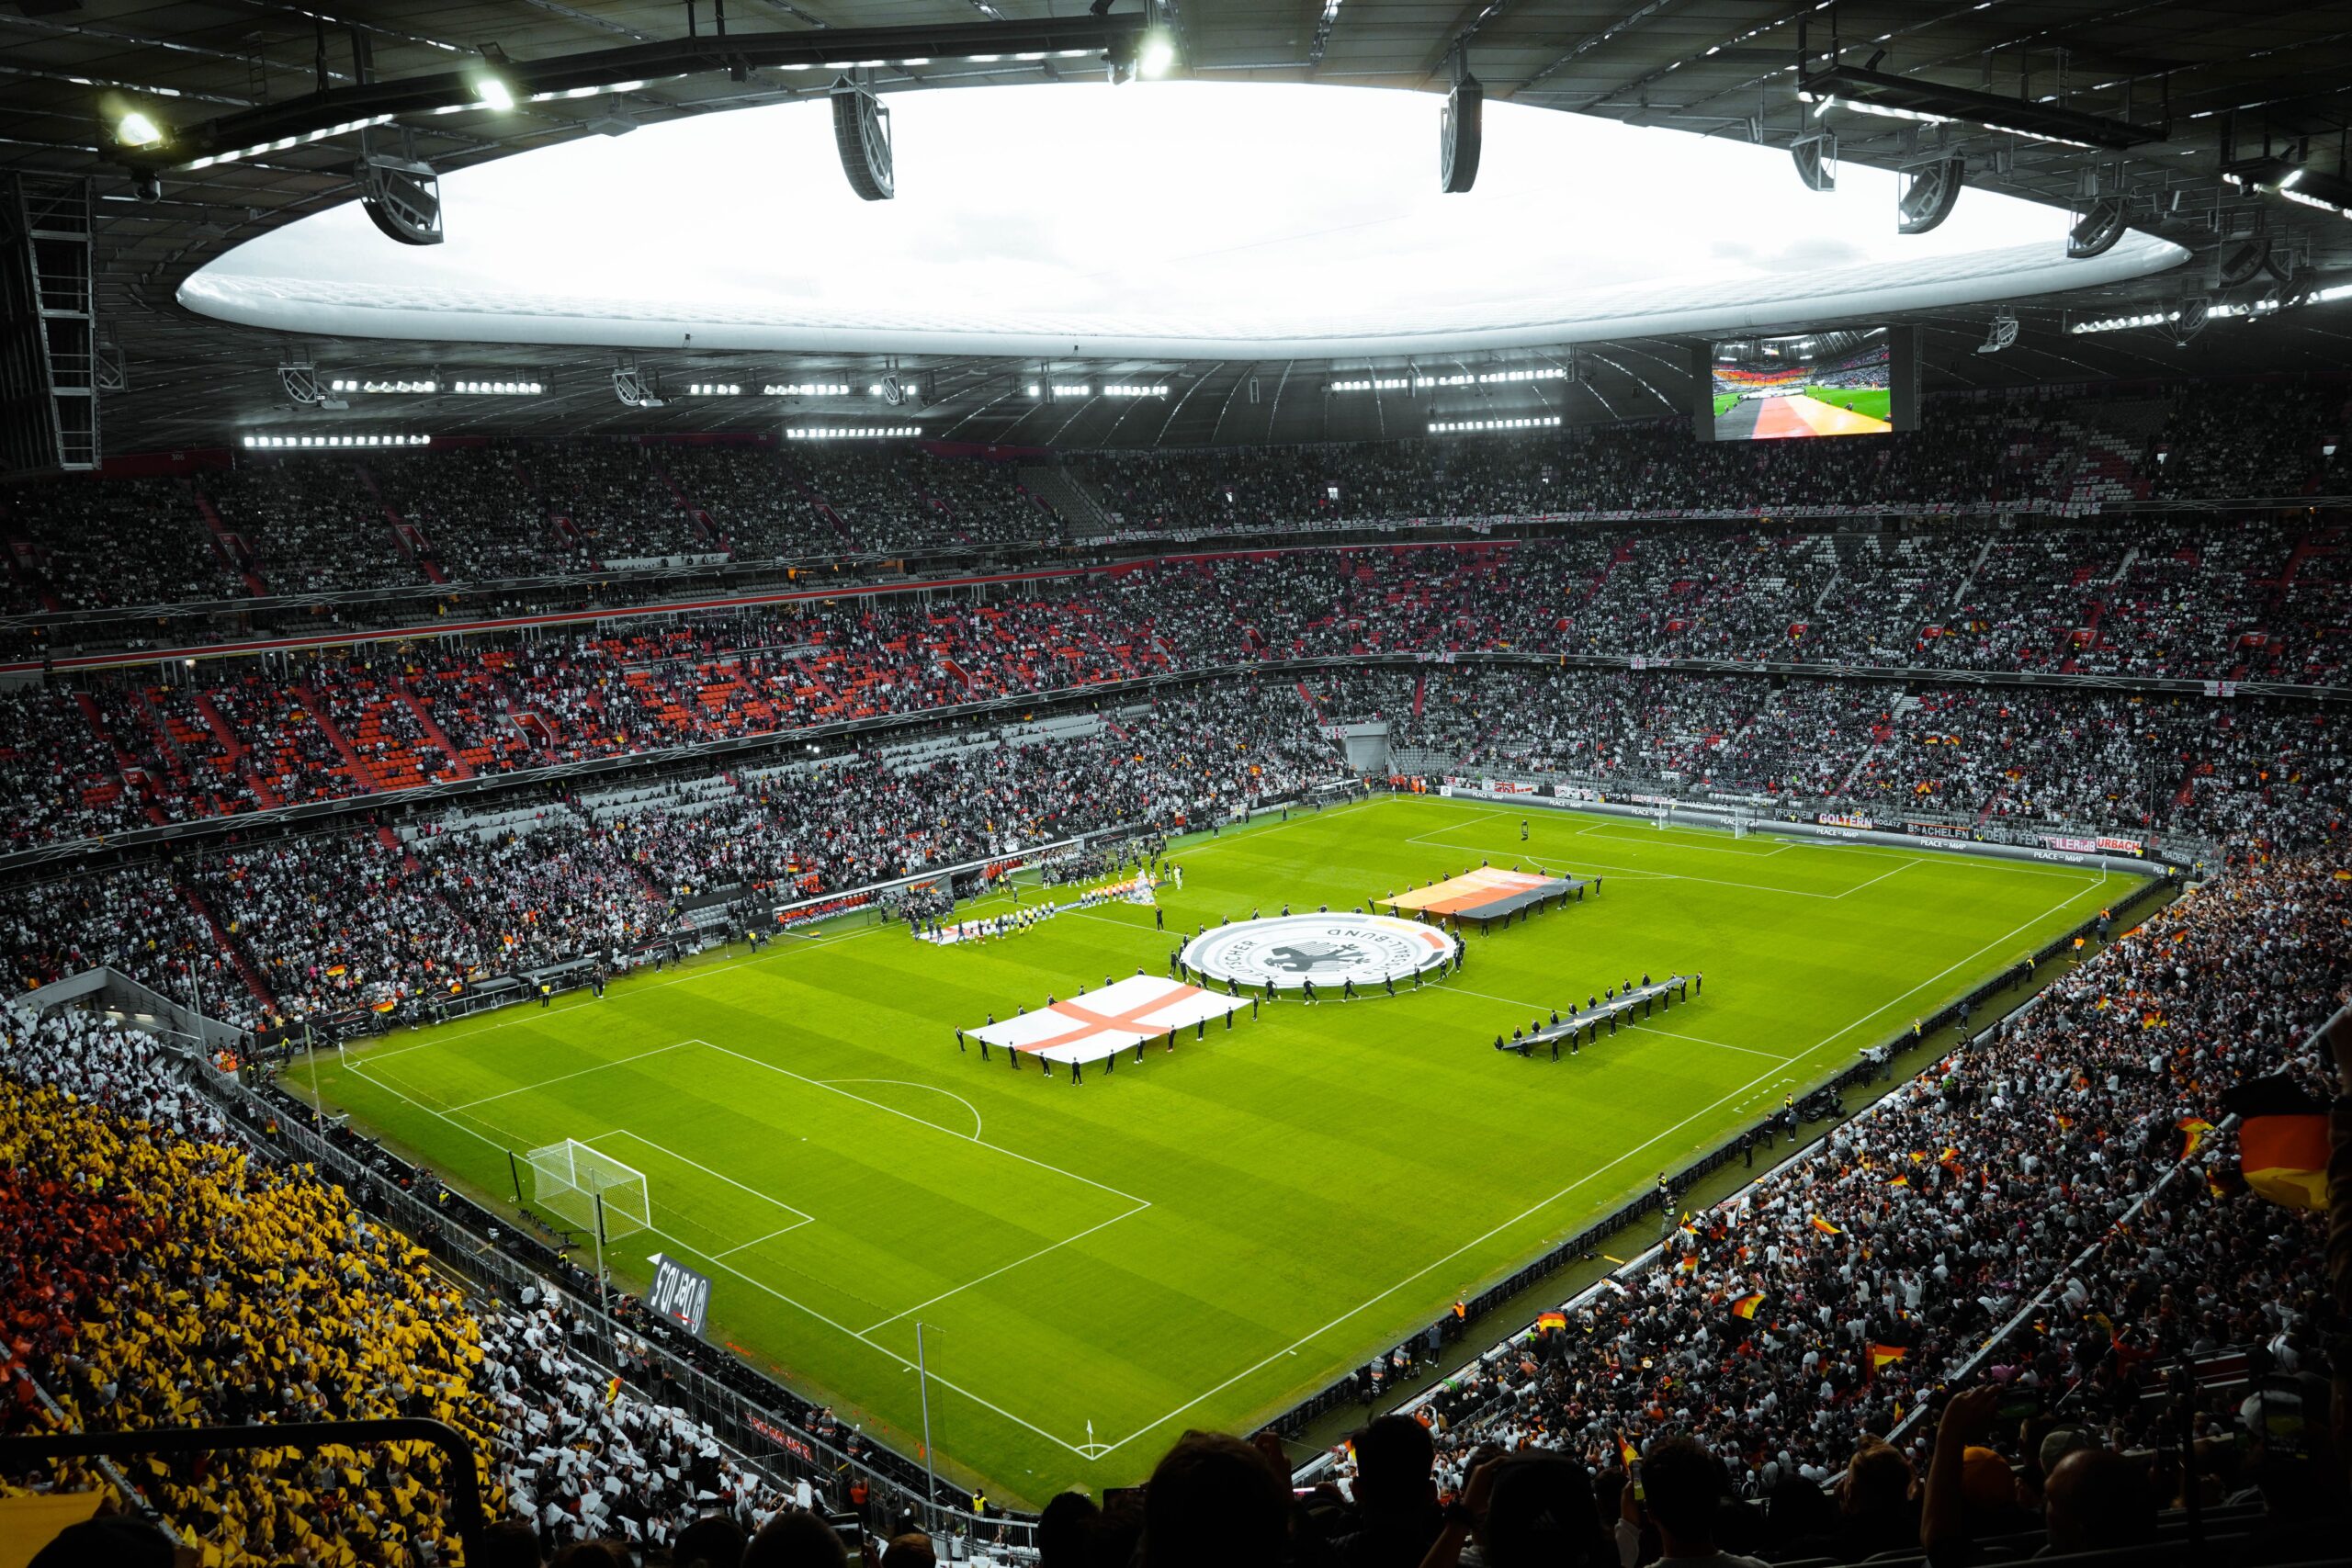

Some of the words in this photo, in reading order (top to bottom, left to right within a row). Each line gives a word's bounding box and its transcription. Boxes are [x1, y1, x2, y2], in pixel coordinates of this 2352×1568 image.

[1819, 813, 1872, 829] GOLTERN
[1920, 840, 1942, 848] PEACE
[2039, 836, 2096, 852] EILERidB
[2098, 837, 2141, 852] URBACH
[2034, 852, 2058, 860] PEACE
[2161, 850, 2192, 864] HADERN
[1225, 941, 1280, 979] DEUTSCHER
[650, 1261, 680, 1315] ID.5
[673, 1272, 696, 1325] Der
